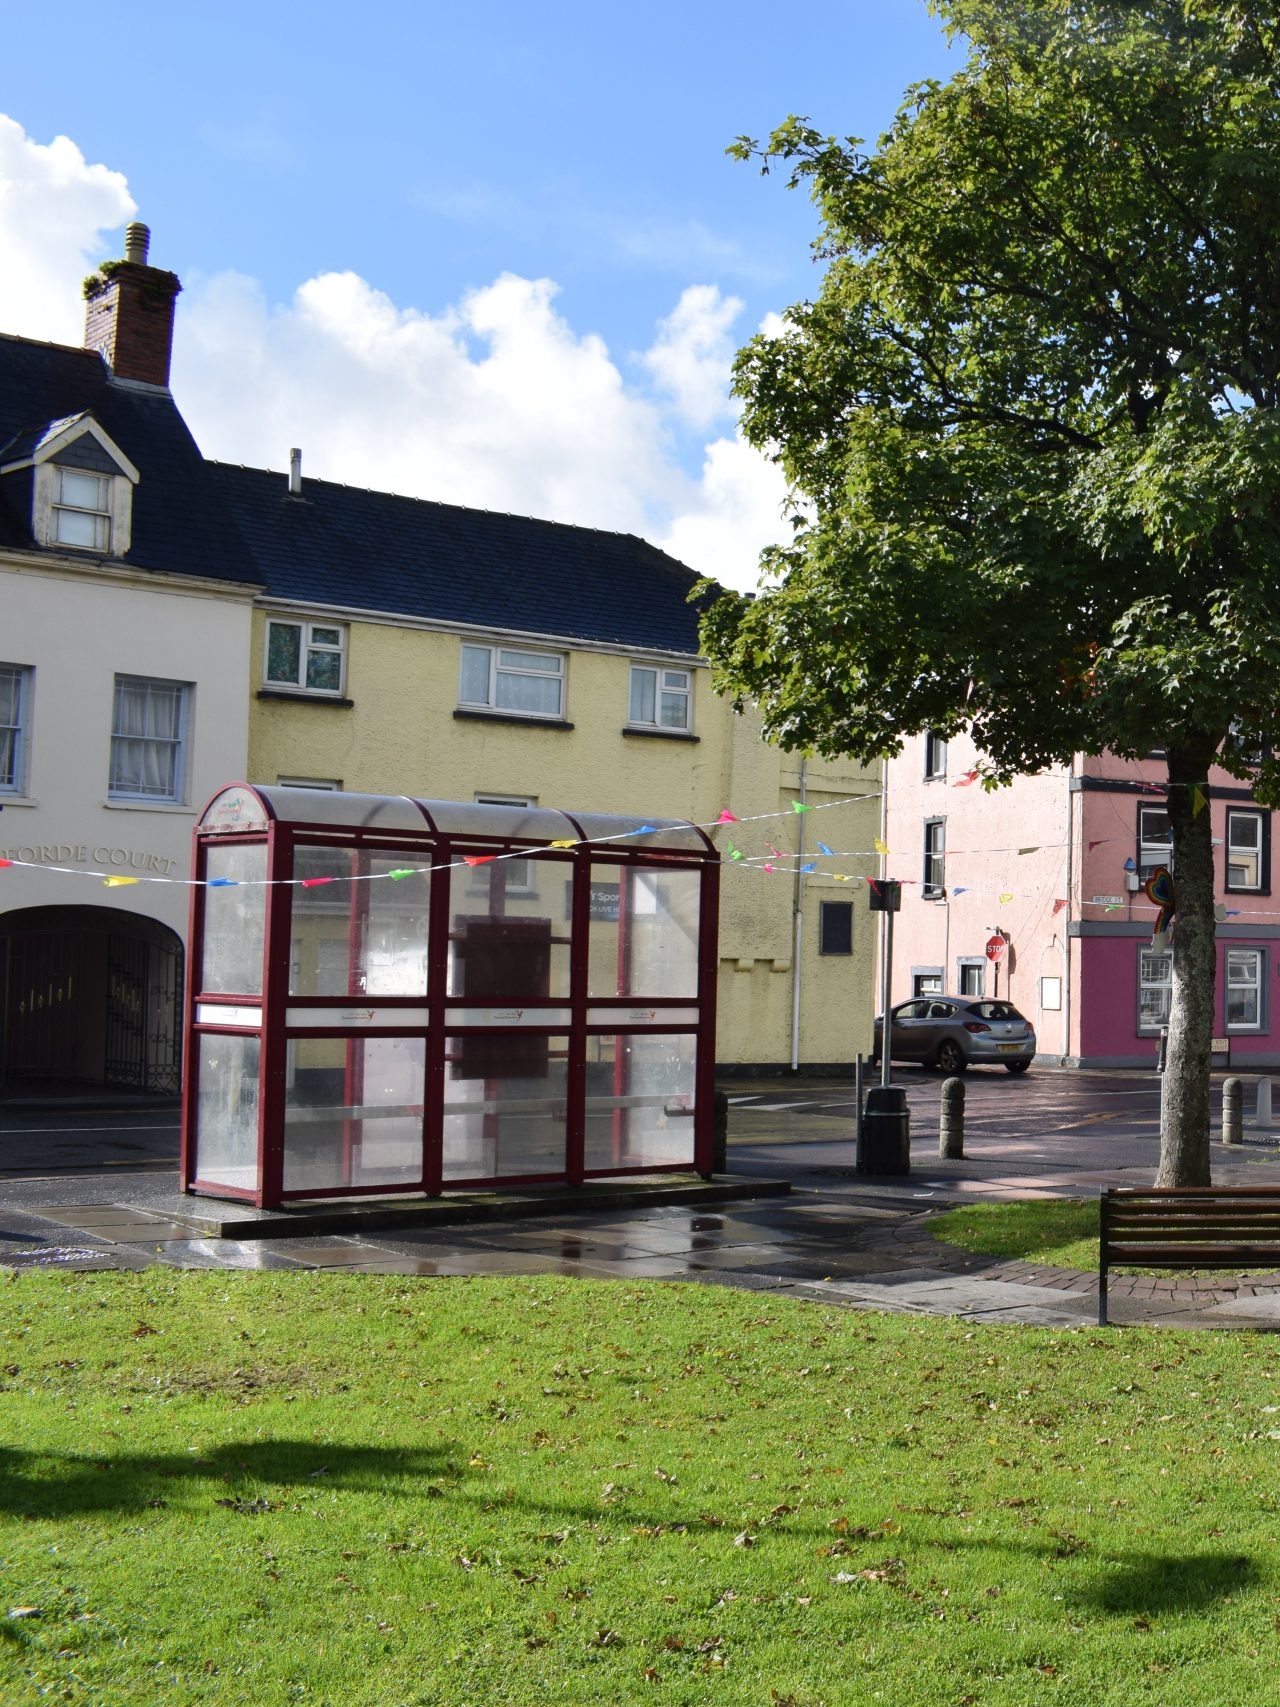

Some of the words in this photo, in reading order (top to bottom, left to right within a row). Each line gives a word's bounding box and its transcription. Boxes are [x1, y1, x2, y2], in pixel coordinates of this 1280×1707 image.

[93, 847, 177, 876] COURT
[598, 892, 621, 903] Spor
[987, 945, 1005, 953] STOP
